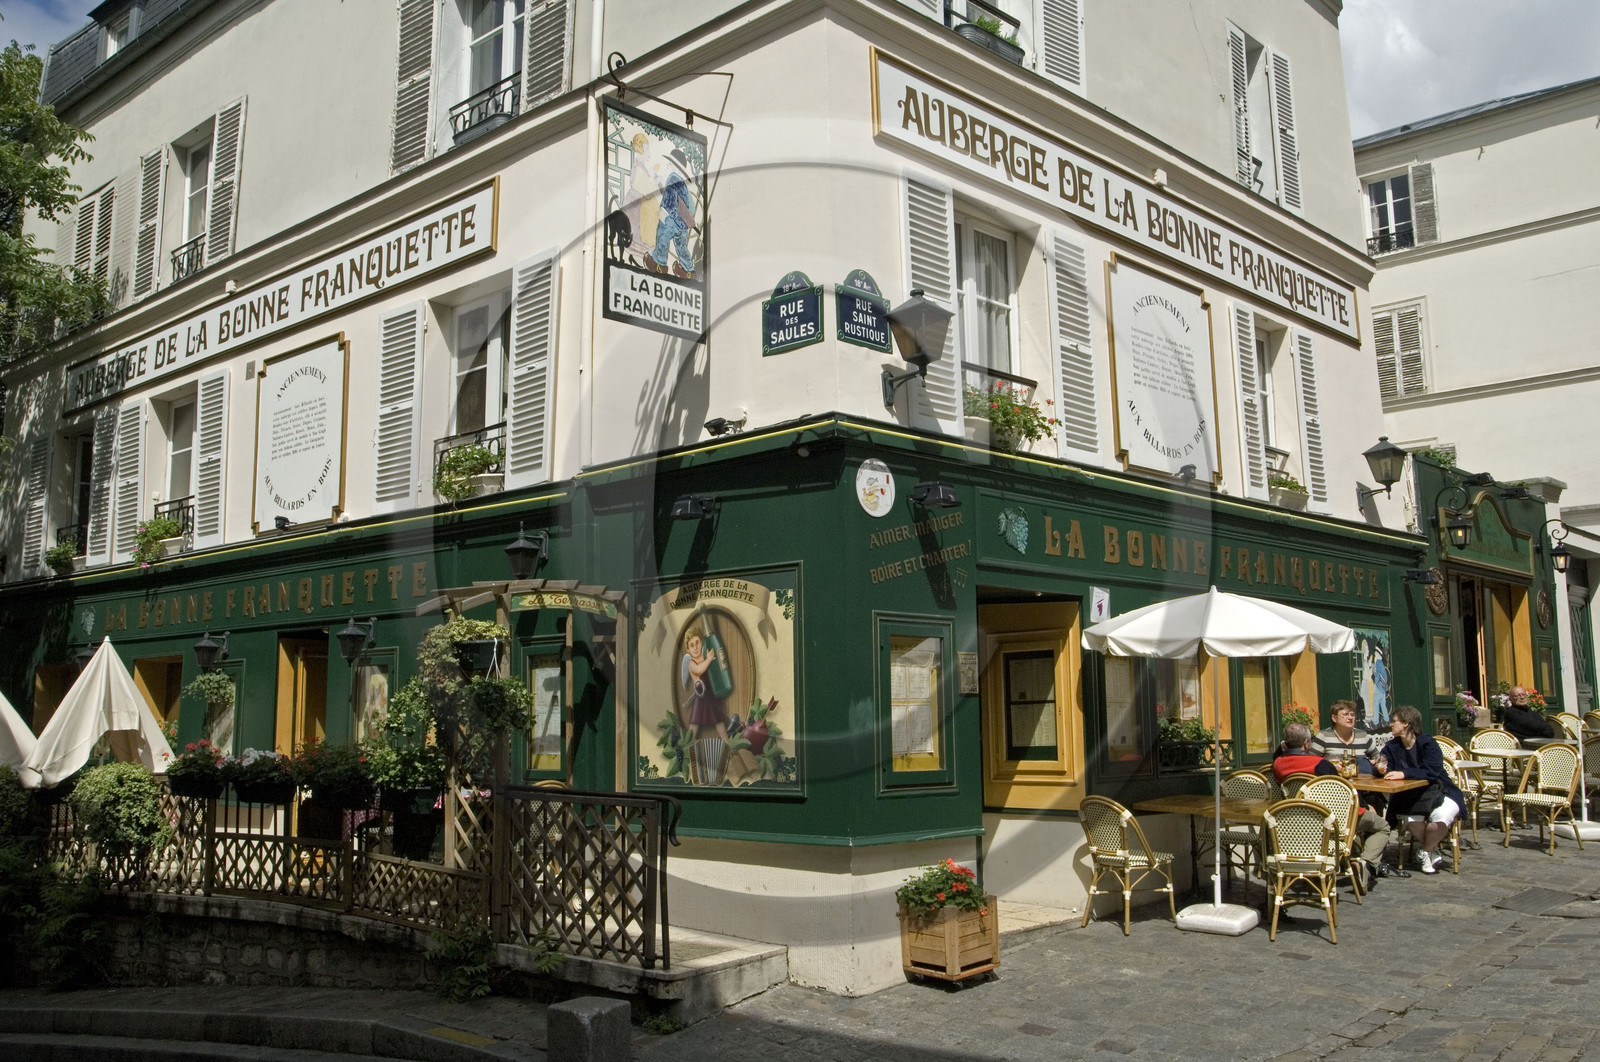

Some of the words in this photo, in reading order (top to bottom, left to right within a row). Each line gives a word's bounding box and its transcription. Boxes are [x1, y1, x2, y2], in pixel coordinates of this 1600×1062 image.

[898, 85, 1049, 192] AUBERGE
[1058, 157, 1096, 212] DE
[1103, 178, 1138, 232] LA
[1146, 199, 1224, 270] BONNE
[1228, 239, 1349, 328] FRANQUETTE
[75, 346, 148, 401] AUBERGE
[154, 333, 178, 370] DE
[186, 320, 208, 357] LA
[218, 284, 290, 345] BONNE
[300, 204, 476, 312] FRANQUETTE
[630, 275, 650, 296] LA
[654, 282, 700, 310] BONNE
[614, 292, 700, 330] FRANQUETTE
[780, 300, 804, 318] RUE
[852, 310, 876, 328] SAINT
[856, 298, 872, 314] RUE
[1133, 294, 1191, 334] ANCIENNEMENT
[770, 322, 815, 344] SAULES
[786, 316, 798, 326] DES
[844, 322, 886, 344] RUSTIQUE
[276, 366, 328, 402] ANCIENNEMENT
[1143, 428, 1182, 458] BILLARDS
[1184, 442, 1194, 456] EN
[274, 494, 304, 510] BILLARDS
[308, 486, 318, 502] EN
[318, 458, 332, 485] BOIS
[914, 512, 964, 536] MANGER
[1044, 516, 1086, 560] LA
[1103, 525, 1207, 576] BONNE
[1220, 546, 1379, 599] FRANQUETTE
[870, 561, 902, 584] BOIRE
[904, 558, 918, 574] ET
[104, 604, 127, 632] LA
[138, 592, 213, 628] BONNE
[226, 562, 427, 618] FRANQUETTE
[528, 594, 544, 606] La
[670, 592, 697, 610] BONNE
[700, 589, 754, 602] FRANQUETTE
[682, 580, 720, 594] AUBERGE
[724, 580, 735, 588] DE
[737, 582, 748, 591] LA
